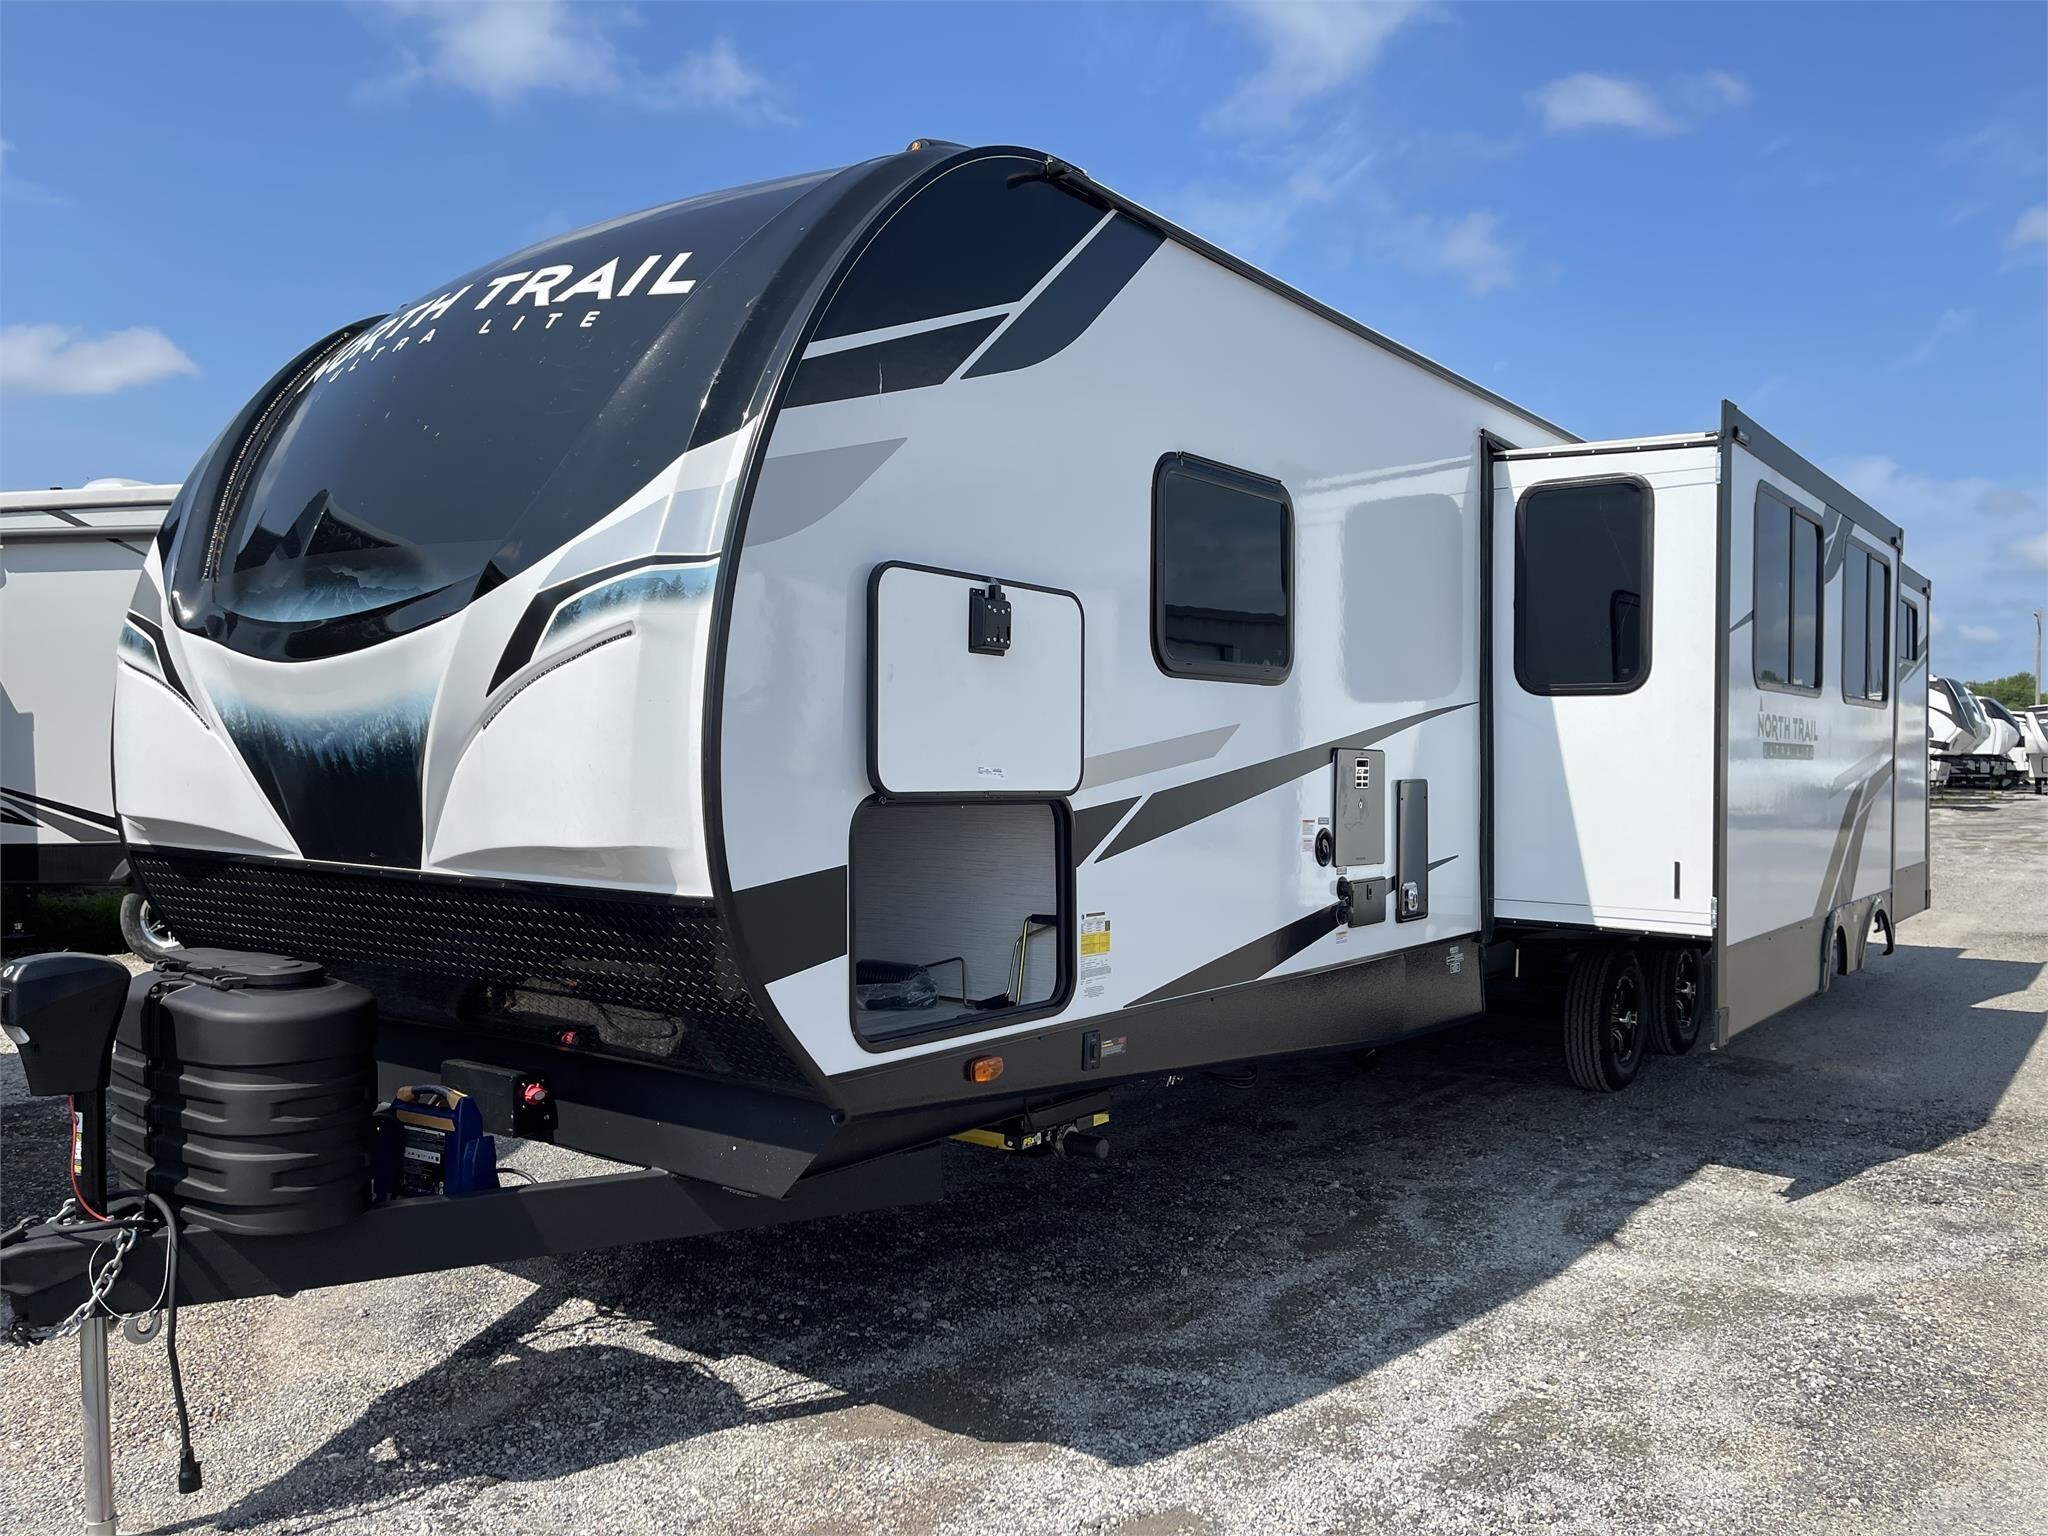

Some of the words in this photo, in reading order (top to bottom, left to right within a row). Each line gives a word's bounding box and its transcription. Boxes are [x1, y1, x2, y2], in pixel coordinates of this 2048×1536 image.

[298, 284, 474, 393] NORTH
[474, 252, 696, 311] TRAIL
[329, 328, 436, 383] ULTRA
[478, 311, 601, 335] LITE
[1757, 713, 1791, 740] NORTH
[1793, 717, 1818, 743] TRAIL
